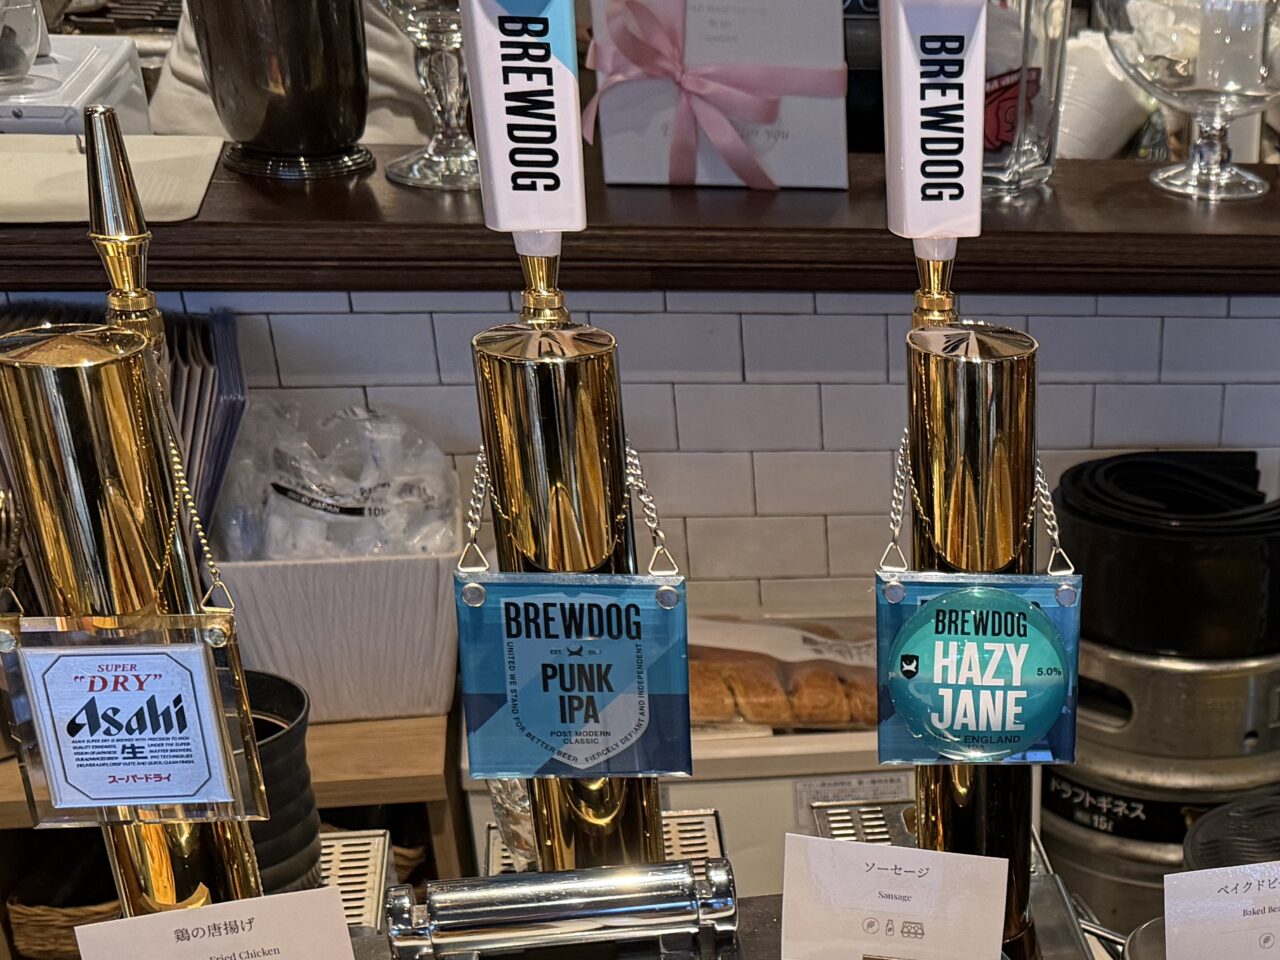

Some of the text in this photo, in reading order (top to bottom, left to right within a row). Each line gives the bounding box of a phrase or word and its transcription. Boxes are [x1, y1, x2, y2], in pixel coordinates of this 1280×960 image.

[498, 16, 561, 191] BREWDOG
[920, 35, 965, 201] BREWDOG
[504, 601, 642, 641] BREWDOG
[934, 609, 1028, 638] BREWDOG
[97, 663, 137, 673] SUPER
[933, 640, 1030, 686] HAZY
[1036, 667, 1062, 676] 5.0%
[541, 663, 614, 693] PUNK
[66, 693, 188, 738] Asahi
[507, 642, 578, 763] UNITED WE STAND FOR BETTER BEER
[559, 695, 600, 724] IPA
[585, 643, 646, 763] FIERCELY DEFIANT AND INDEPENDENT
[930, 688, 1028, 732] JANE
[121, 743, 148, 760] 生
[964, 735, 1021, 744] ENGLAND
[108, 773, 171, 784] スーパードライ
[864, 862, 930, 878] ソーセージ
[878, 891, 912, 902] Sausage
[1242, 906, 1266, 917] Baked
[173, 916, 256, 944] 鶏の唐揚げ
